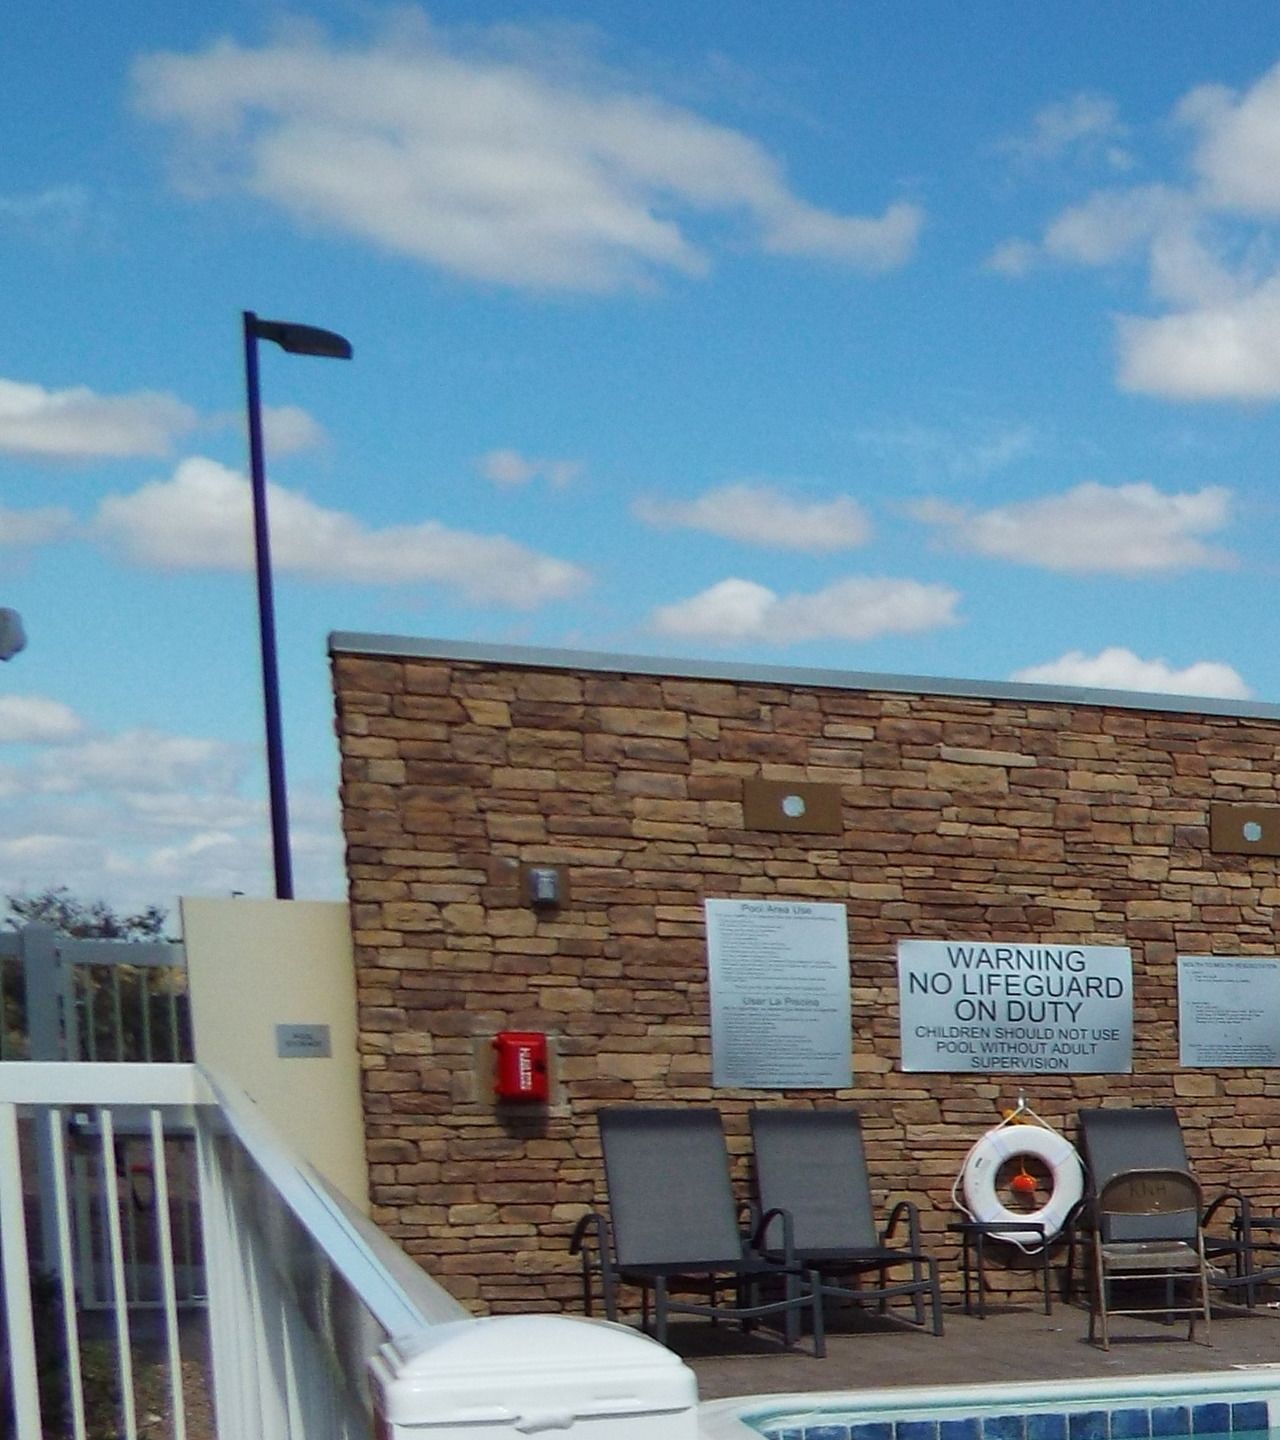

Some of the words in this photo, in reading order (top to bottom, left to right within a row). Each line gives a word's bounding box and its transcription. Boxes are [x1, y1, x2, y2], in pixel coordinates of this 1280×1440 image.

[947, 947, 1086, 972] WARNING
[909, 972, 952, 995] NO
[962, 974, 1124, 999] LIFEGUARD
[954, 999, 996, 1022] ON
[1007, 1000, 1083, 1023] DUTY
[915, 1025, 990, 1039] CHILDREN
[994, 1027, 1054, 1040] SHOULD
[1058, 1029, 1088, 1041] NOT
[1092, 1029, 1120, 1041] USE
[936, 1041, 976, 1054] POOL
[980, 1042, 1049, 1055] WITHOUT
[1053, 1043, 1098, 1055] ADULT
[971, 1056, 1069, 1069] SUPERVISION
